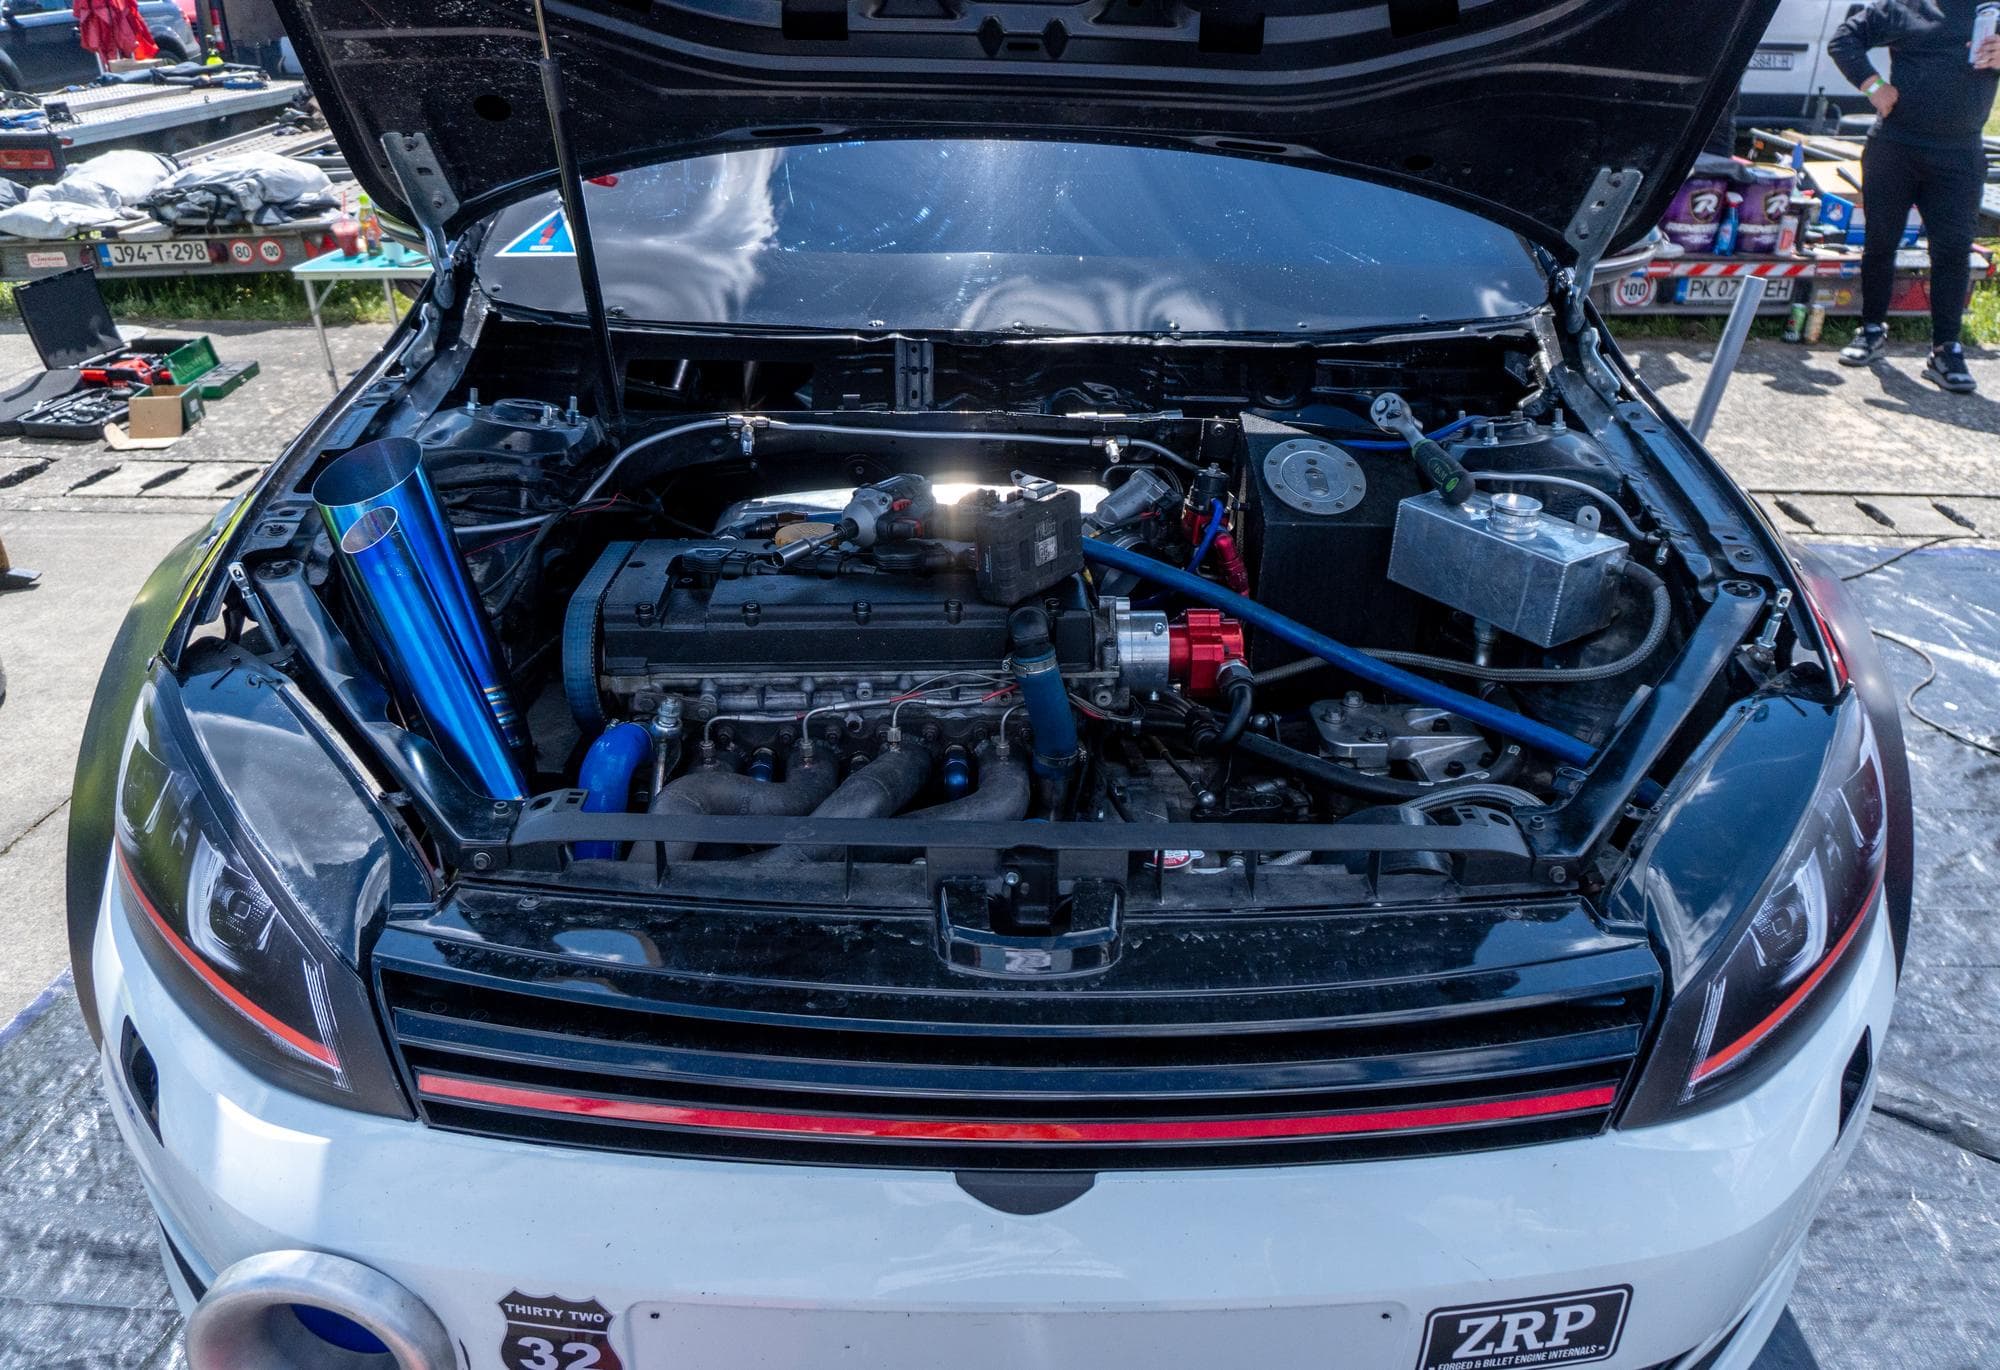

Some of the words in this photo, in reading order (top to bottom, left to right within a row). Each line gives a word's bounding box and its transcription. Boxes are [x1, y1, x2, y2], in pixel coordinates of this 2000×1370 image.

[235, 243, 250, 258] 80
[263, 243, 279, 257] 100
[1624, 283, 1646, 298] 100
[1690, 279, 1714, 298] PK
[505, 1302, 564, 1319] THIRTY
[568, 1310, 605, 1323] TWO
[1451, 1303, 1597, 1360] ZRP
[517, 1336, 601, 1370] 32
[1437, 1360, 1474, 1370] FORGED
[1474, 1360, 1482, 1369] &
[1482, 1355, 1515, 1368] BILLET
[1514, 1351, 1548, 1364] ENGINE
[1547, 1345, 1597, 1360] INTERNALS
